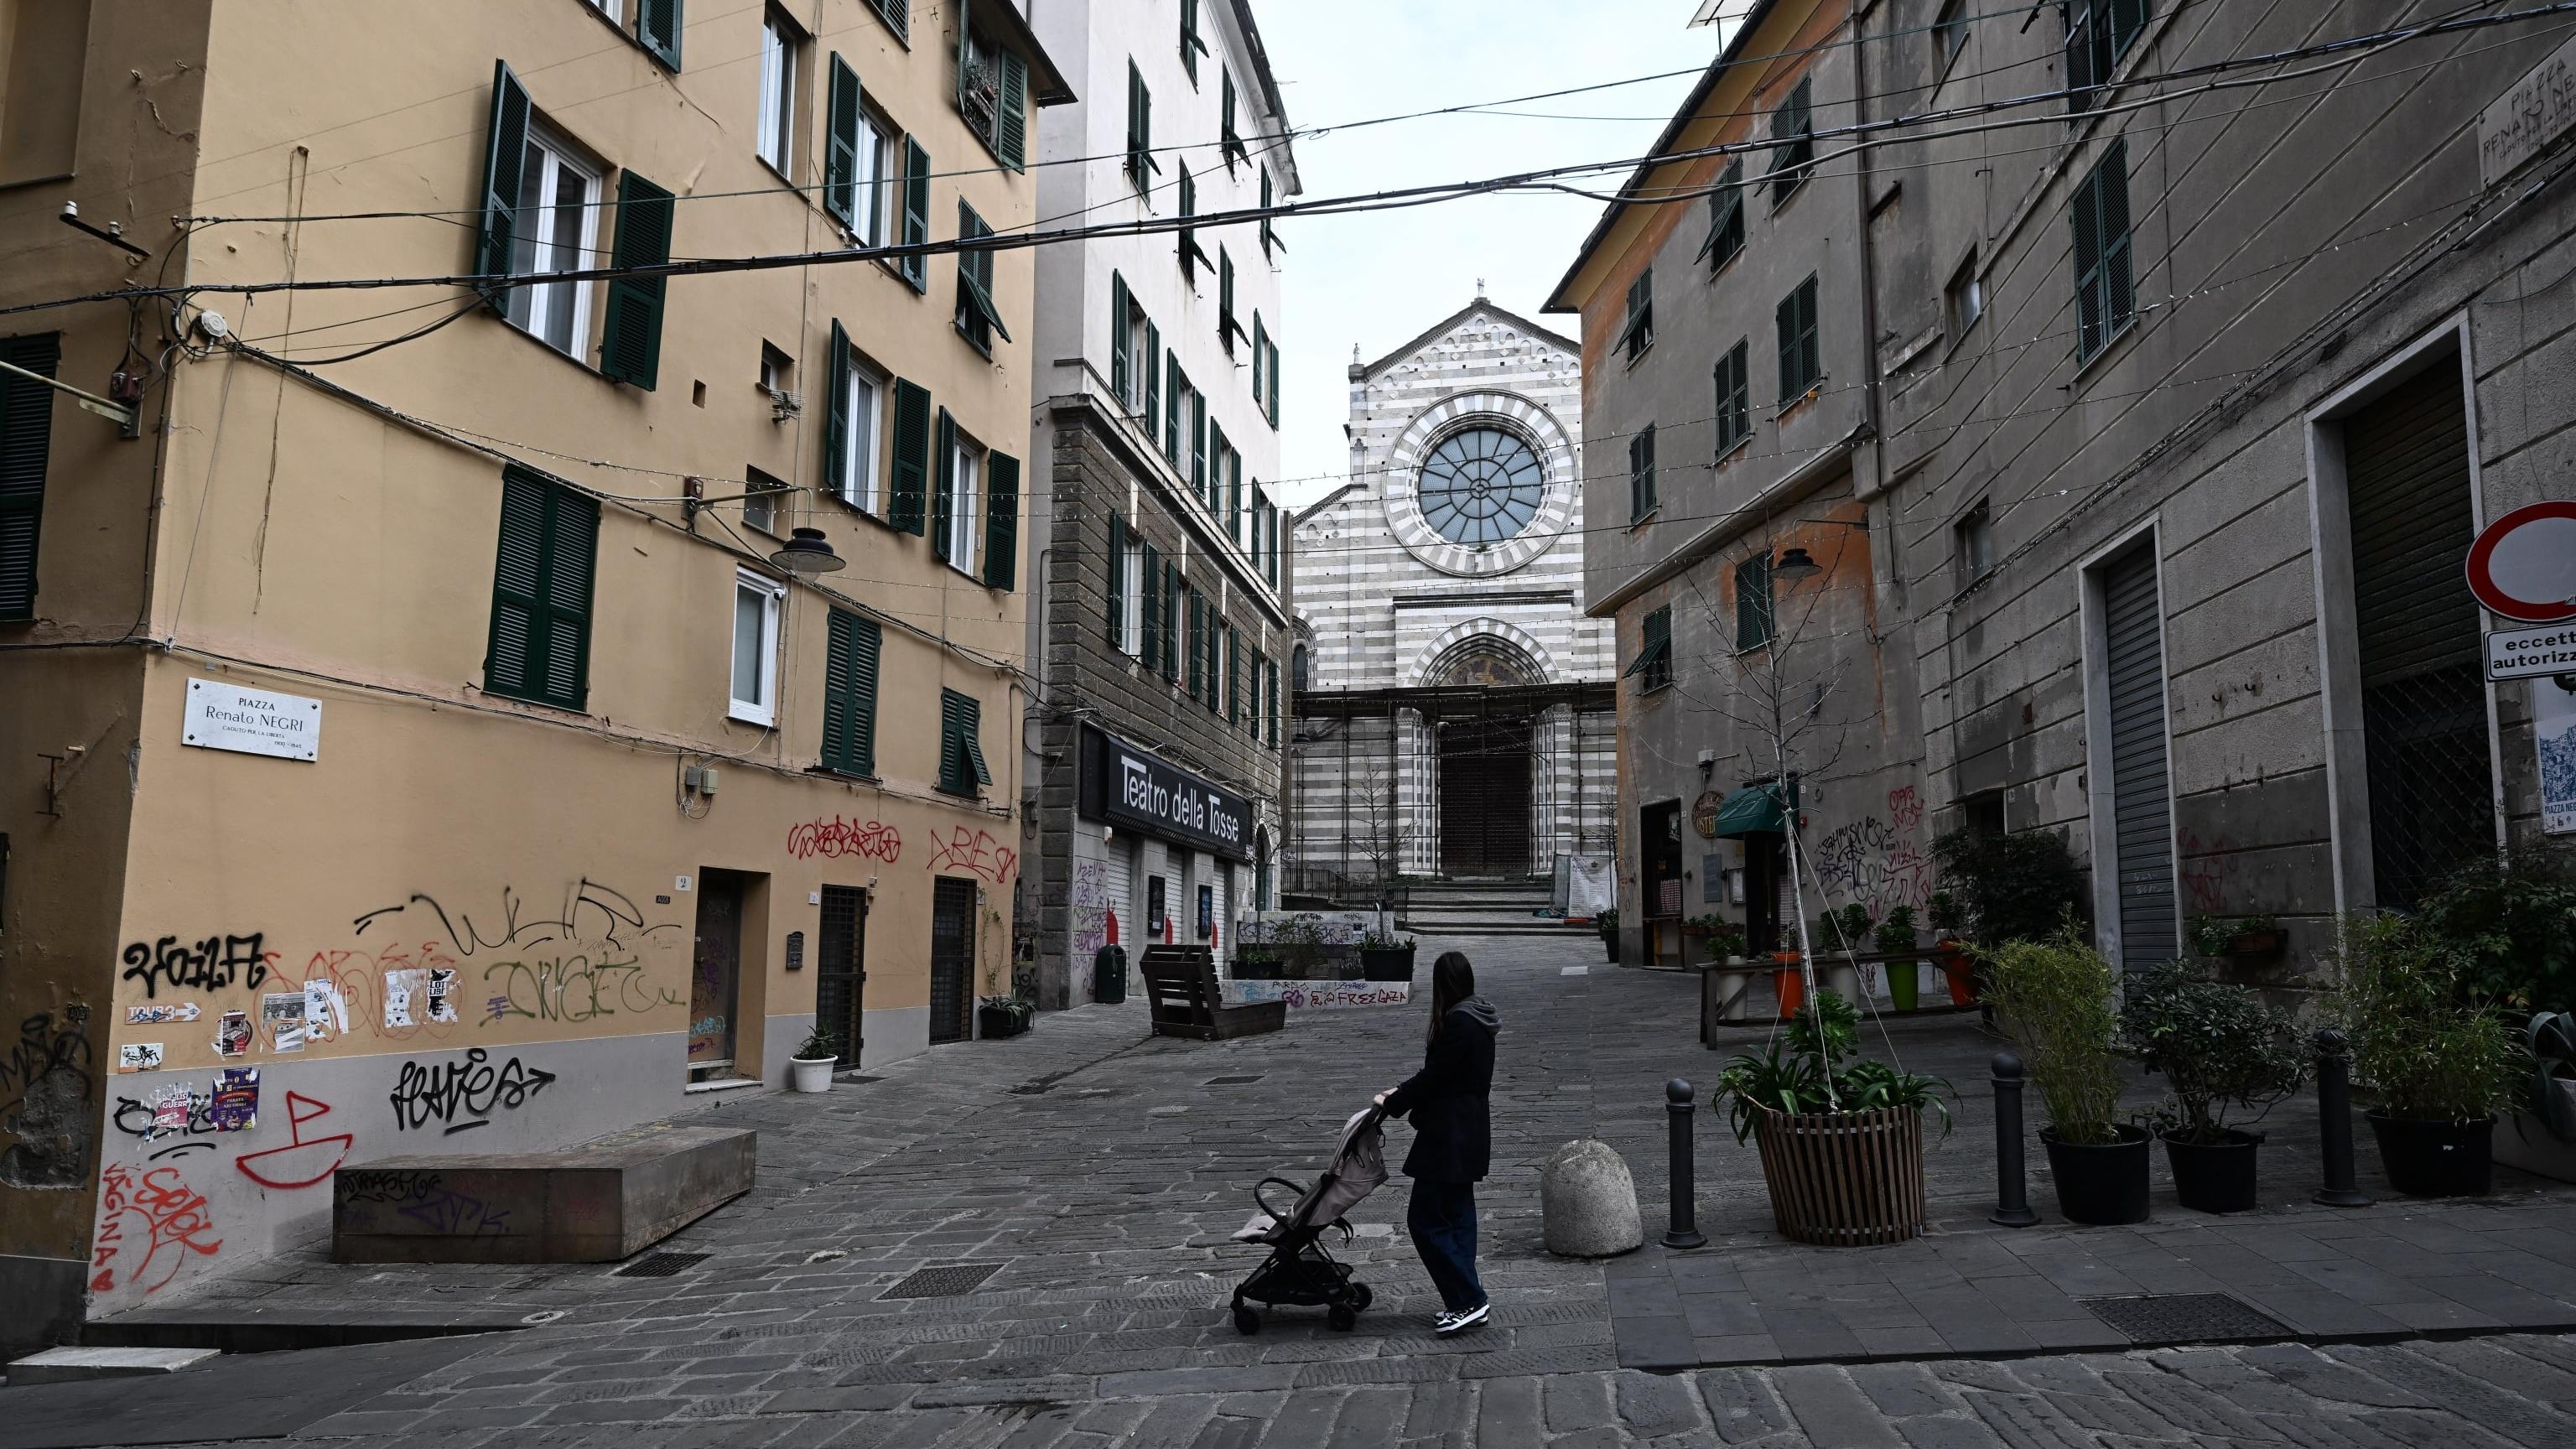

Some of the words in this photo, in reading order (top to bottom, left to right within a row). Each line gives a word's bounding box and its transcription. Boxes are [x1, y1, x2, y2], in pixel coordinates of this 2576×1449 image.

[239, 698, 275, 711] PIAZZA
[206, 706, 254, 724] Renato
[259, 714, 303, 732] NEGRI
[222, 725, 247, 734] CADUTO
[1120, 755, 1168, 818] Teatro
[1172, 782, 1203, 831] della
[1208, 793, 1239, 842] Tosse
[2545, 803, 2564, 814] PIAZZA
[680, 877, 687, 888] 2
